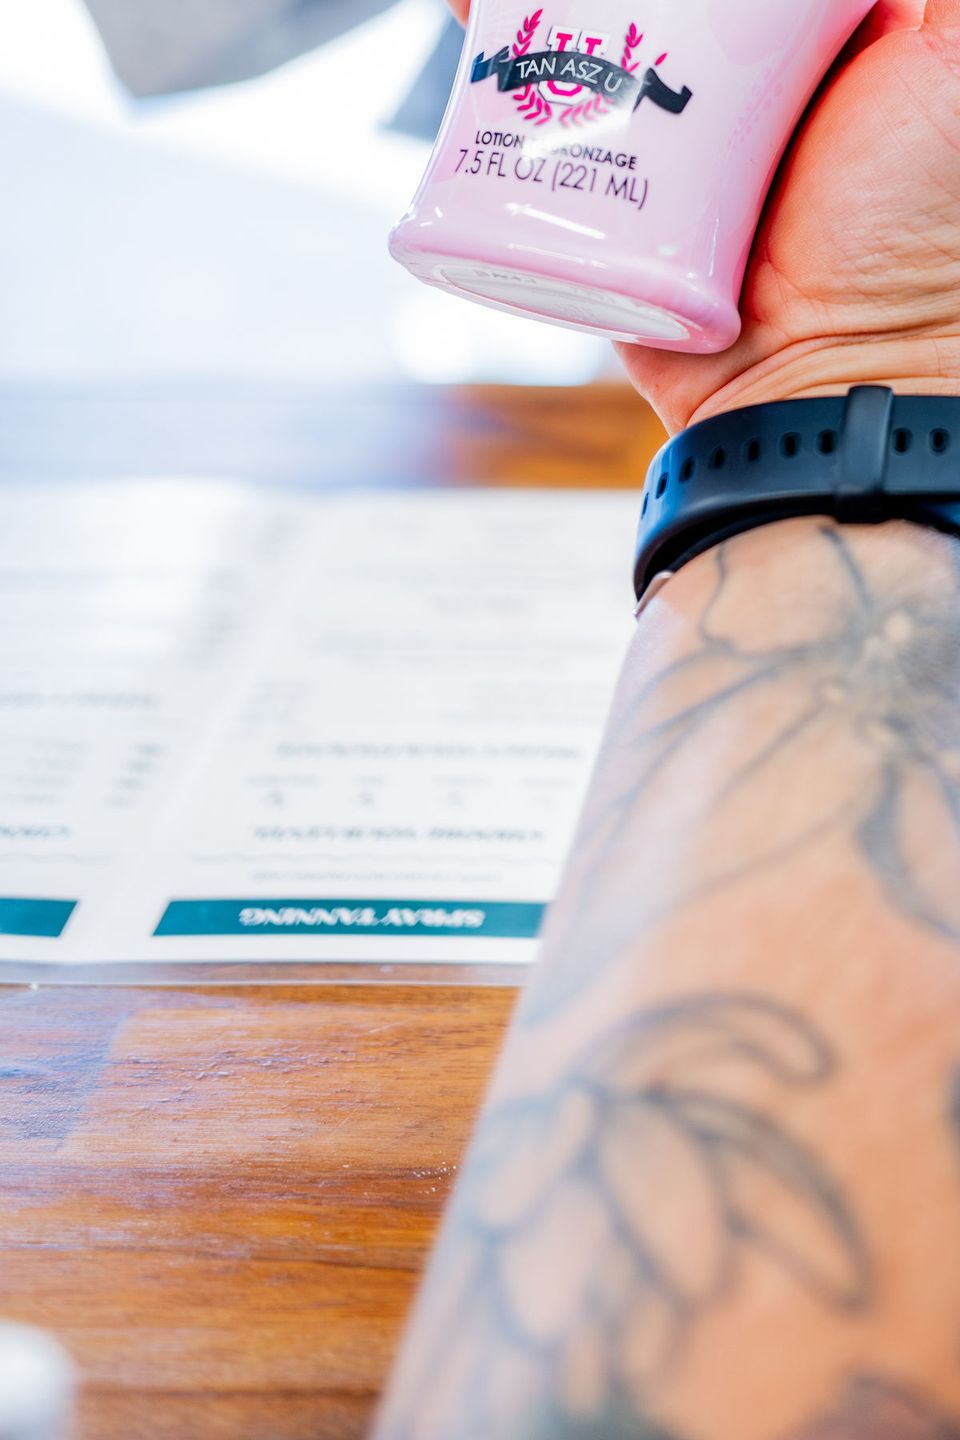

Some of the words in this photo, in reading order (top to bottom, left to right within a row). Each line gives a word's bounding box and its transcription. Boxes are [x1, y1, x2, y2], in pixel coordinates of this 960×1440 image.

[516, 57, 557, 79] TAN
[560, 60, 604, 84] ASZ
[604, 72, 623, 93] U
[475, 131, 526, 148] LOTION
[454, 148, 485, 174] 7.5
[486, 151, 507, 177] FL
[514, 156, 546, 183] OZ
[551, 160, 598, 192] (221
[604, 174, 649, 210] ML)
[238, 906, 377, 927] TANNING
[379, 907, 486, 928] SPRAY
